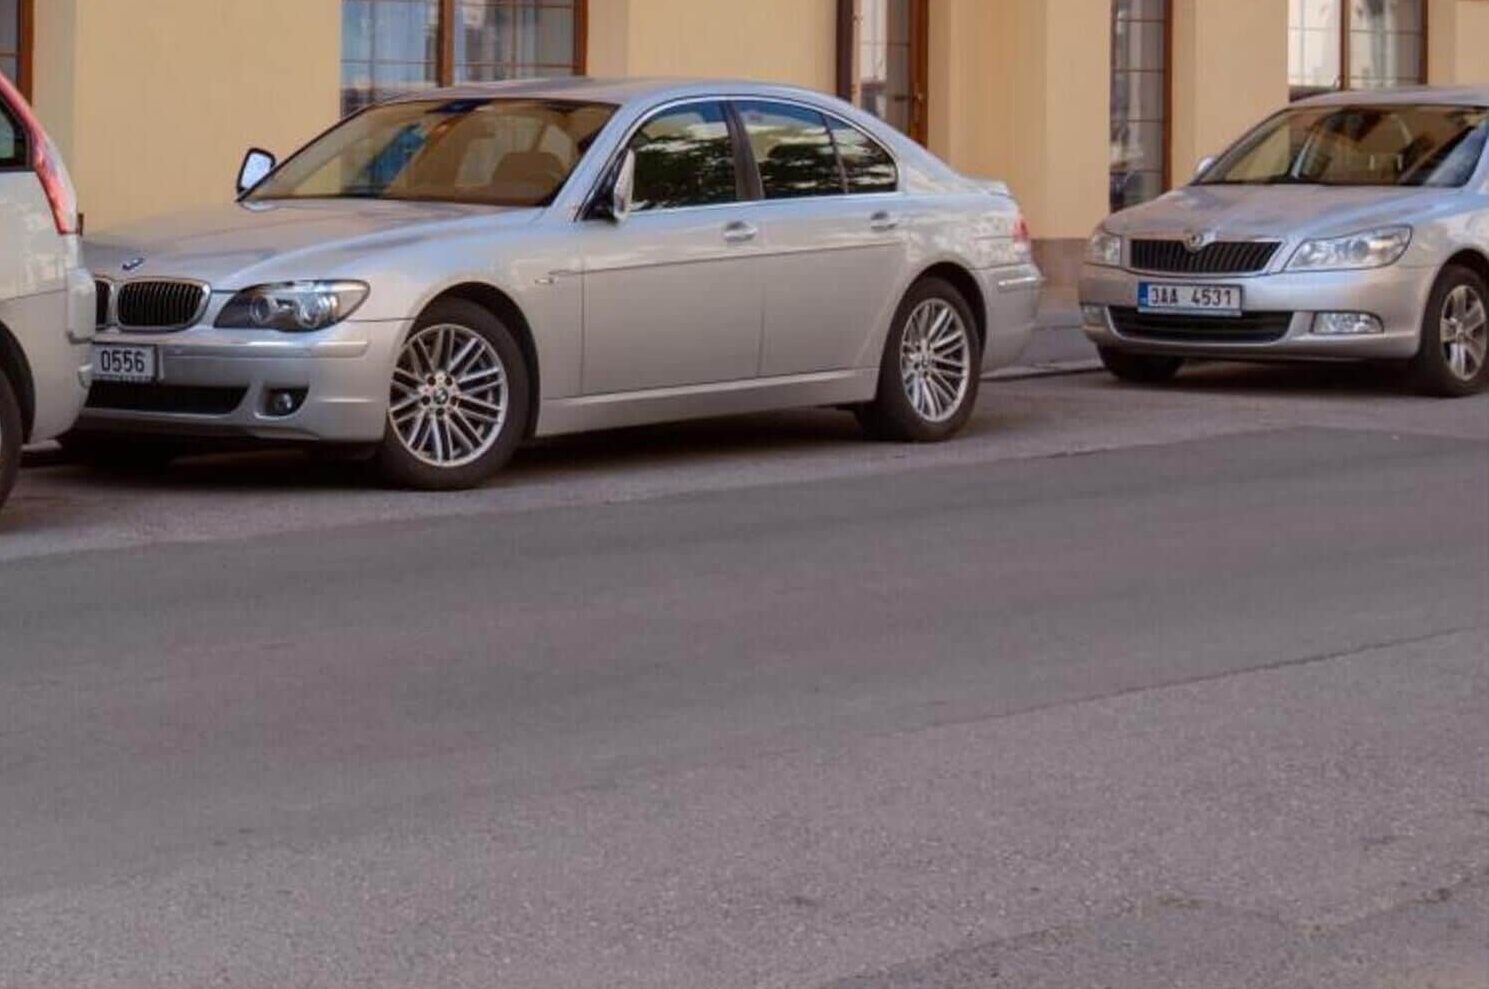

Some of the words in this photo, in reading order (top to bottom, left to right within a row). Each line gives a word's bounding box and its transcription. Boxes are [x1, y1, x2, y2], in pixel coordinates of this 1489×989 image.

[1151, 287, 1179, 304] 3AA
[1191, 288, 1232, 306] 4531
[101, 349, 145, 372] 0556
